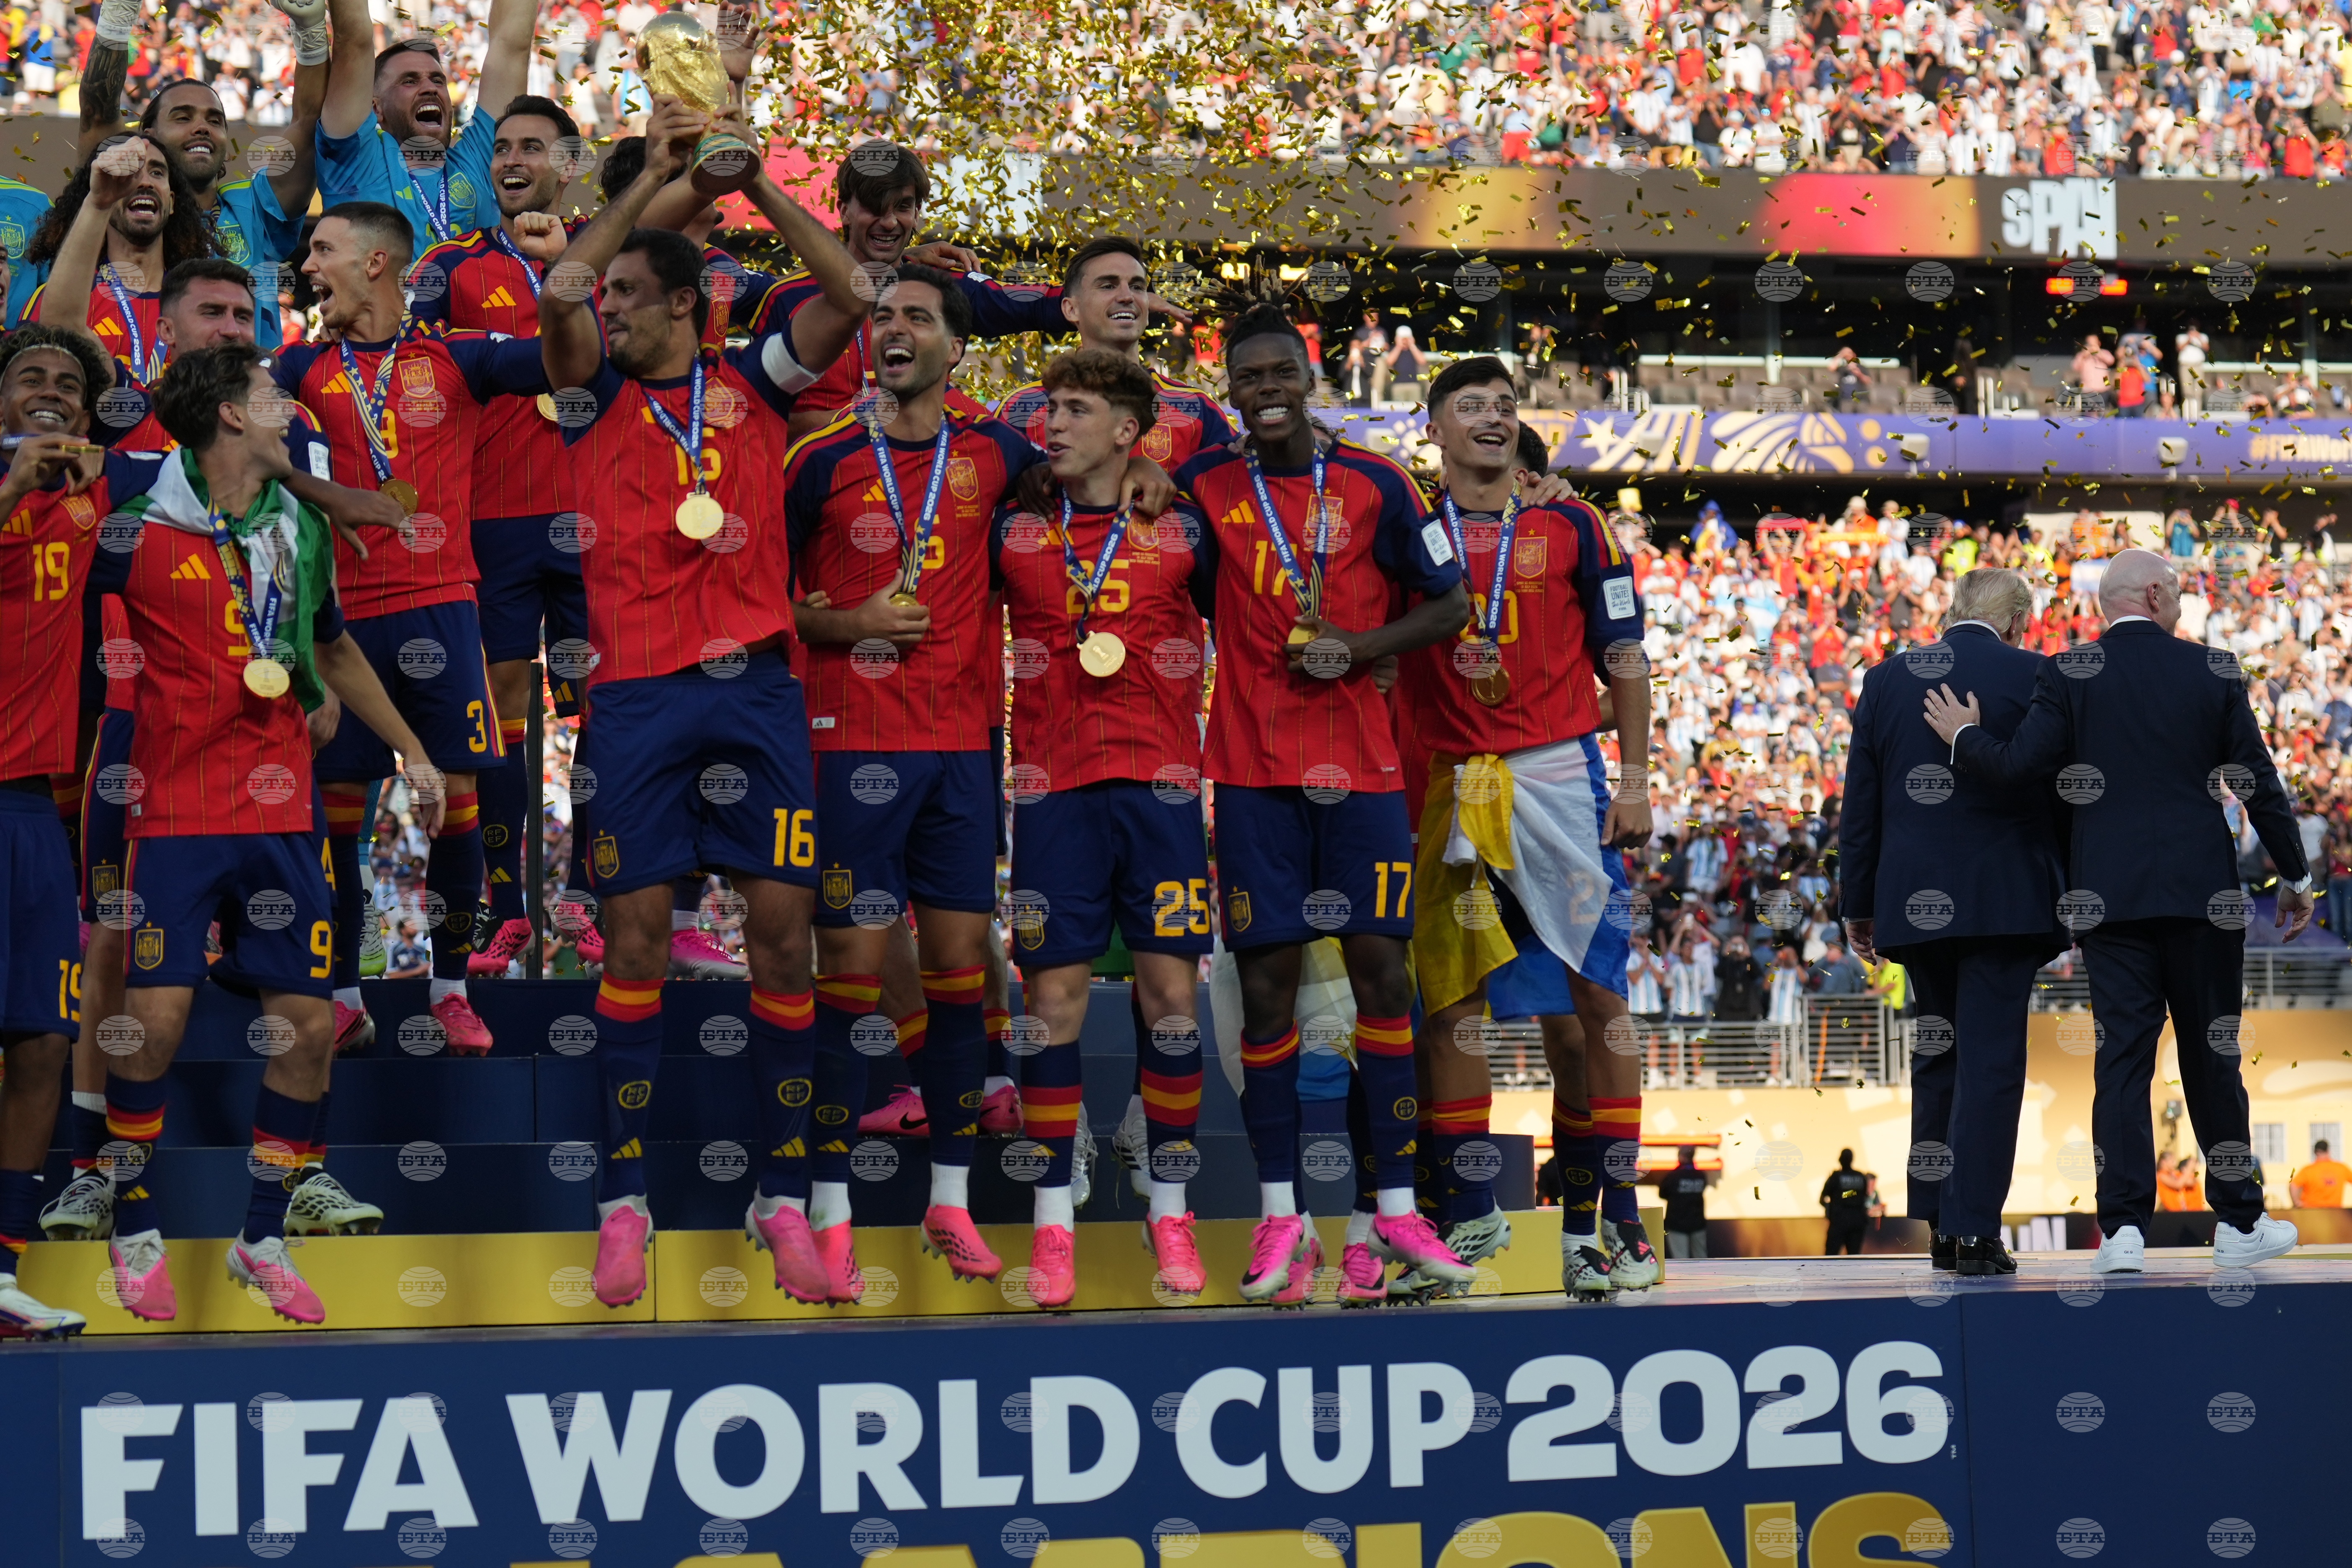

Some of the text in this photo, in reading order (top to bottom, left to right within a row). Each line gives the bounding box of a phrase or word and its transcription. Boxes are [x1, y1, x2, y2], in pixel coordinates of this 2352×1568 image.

[413, 180, 422, 193] FIFA
[420, 193, 435, 217] WORLD
[433, 218, 443, 231] CUP
[520, 260, 537, 284] WORLD
[114, 287, 124, 301] FIFA
[121, 300, 134, 323] WORLD
[694, 378, 702, 405] WORLD
[660, 413, 682, 438] WORLD
[371, 454, 382, 469] CUP
[877, 447, 887, 465] FIFA
[882, 464, 895, 494] WORLD
[889, 494, 900, 511] CUP
[931, 475, 940, 493] CUP
[934, 447, 946, 476] WORLD
[923, 492, 936, 521] 2026
[1253, 474, 1292, 563] FIFA WORLD CUP 2026
[1096, 561, 1107, 578] CUP
[1104, 533, 1119, 562] 2026
[1447, 499, 1467, 570] WORLD CUP 2026
[33, 542, 70, 602] 19
[1066, 559, 1130, 614] 25
[1253, 540, 1297, 596] 17
[1488, 536, 1509, 629] FIFA WORLD CUP 2026
[1610, 583, 1629, 592] FOOTBALL
[267, 598, 278, 617] FIFA
[1611, 590, 1630, 600] UNITES
[249, 623, 261, 642] FIFA
[467, 700, 487, 753] 3
[773, 808, 814, 868] 16
[1155, 878, 1210, 937] 25
[1375, 861, 1411, 918] 17
[310, 920, 332, 979] 9
[81, 1396, 479, 1540] FIFA
[506, 1375, 1140, 1524] WORLD
[1174, 1362, 1475, 1498] CUP
[1505, 1341, 1949, 1482] 2026
